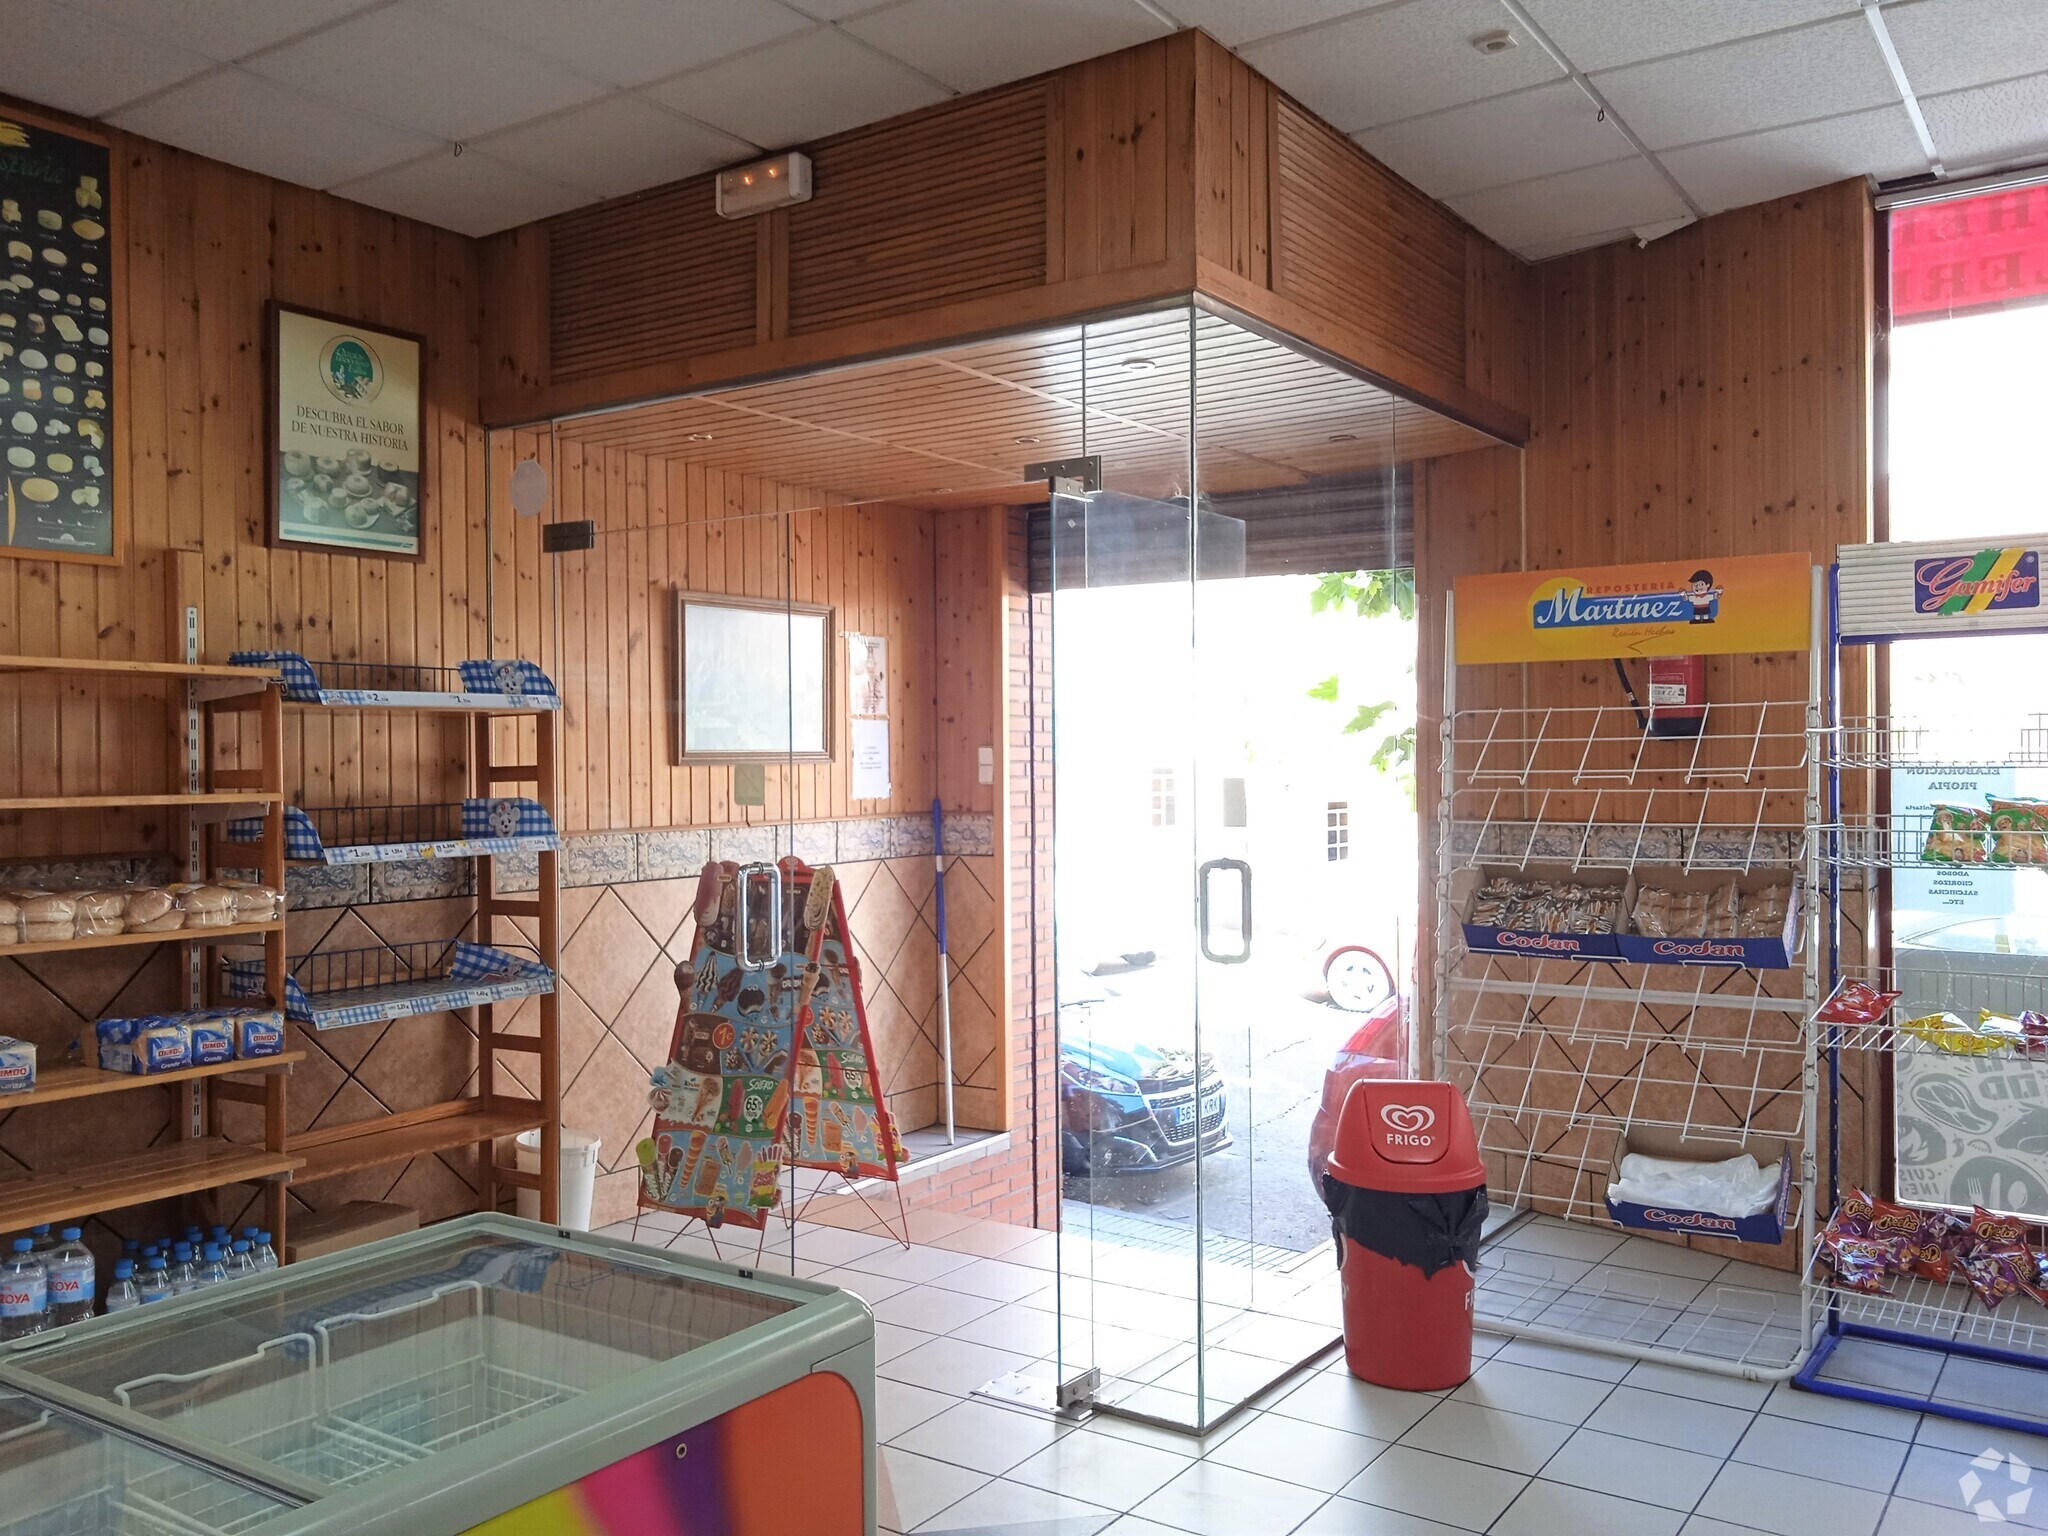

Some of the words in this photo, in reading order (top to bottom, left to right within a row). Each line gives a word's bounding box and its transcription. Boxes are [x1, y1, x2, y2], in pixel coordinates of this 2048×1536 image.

[296, 405, 354, 426] DESCUBRA
[356, 416, 369, 430] EL
[370, 419, 405, 436] SABOR
[291, 419, 307, 434] DE
[309, 423, 358, 443] NUESTRA
[361, 433, 409, 451] HISTORIA
[1586, 582, 1676, 594] REPOSTERIA
[1916, 554, 2036, 612] Gamifer
[1536, 585, 1683, 625] Martínez
[1497, 931, 1580, 952] Codan
[1653, 940, 1744, 957] Codan
[0, 1067, 27, 1078] IMBO
[1386, 1134, 1432, 1147] FRIGO
[1644, 1208, 1737, 1231] Codan
[1876, 1215, 1919, 1232] Cheetos
